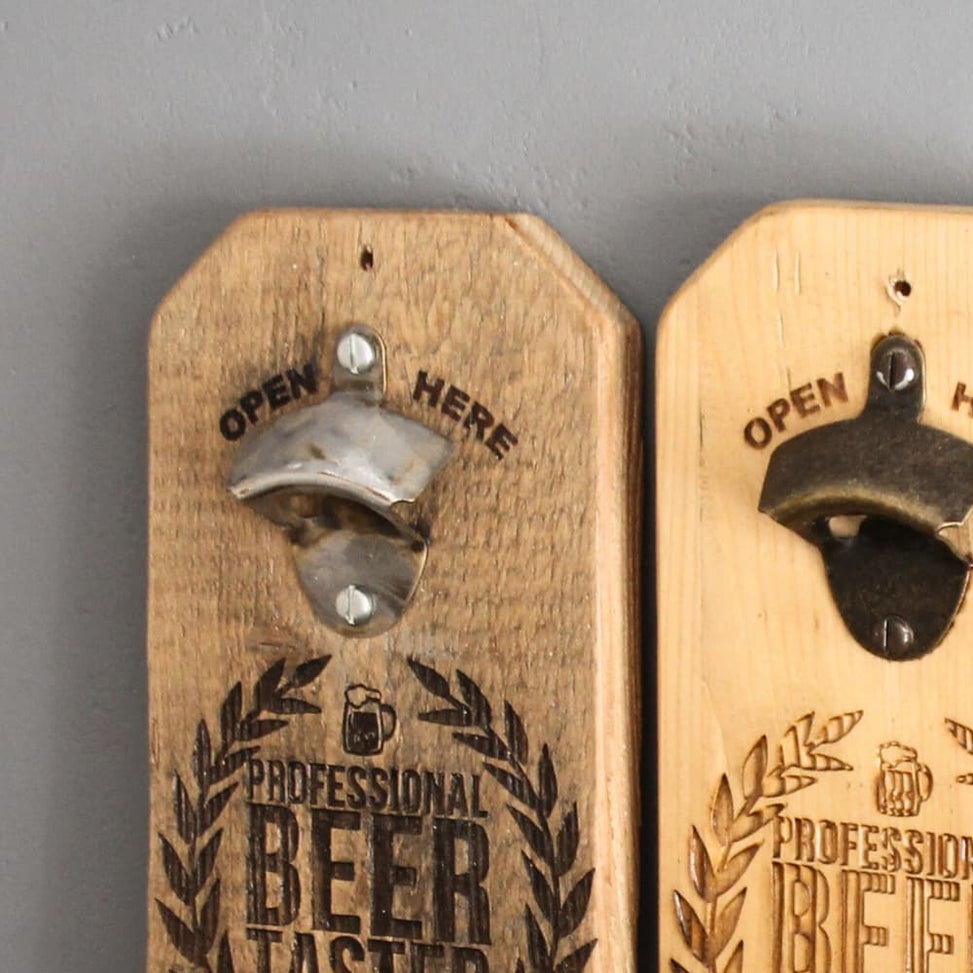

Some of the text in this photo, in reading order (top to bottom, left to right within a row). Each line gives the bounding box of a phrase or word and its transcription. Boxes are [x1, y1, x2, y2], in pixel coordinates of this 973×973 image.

[219, 362, 518, 460] OPEN HERE
[743, 372, 849, 450] OPEN
[247, 757, 489, 818] PROFESSIONAL
[245, 801, 492, 946] BEER
